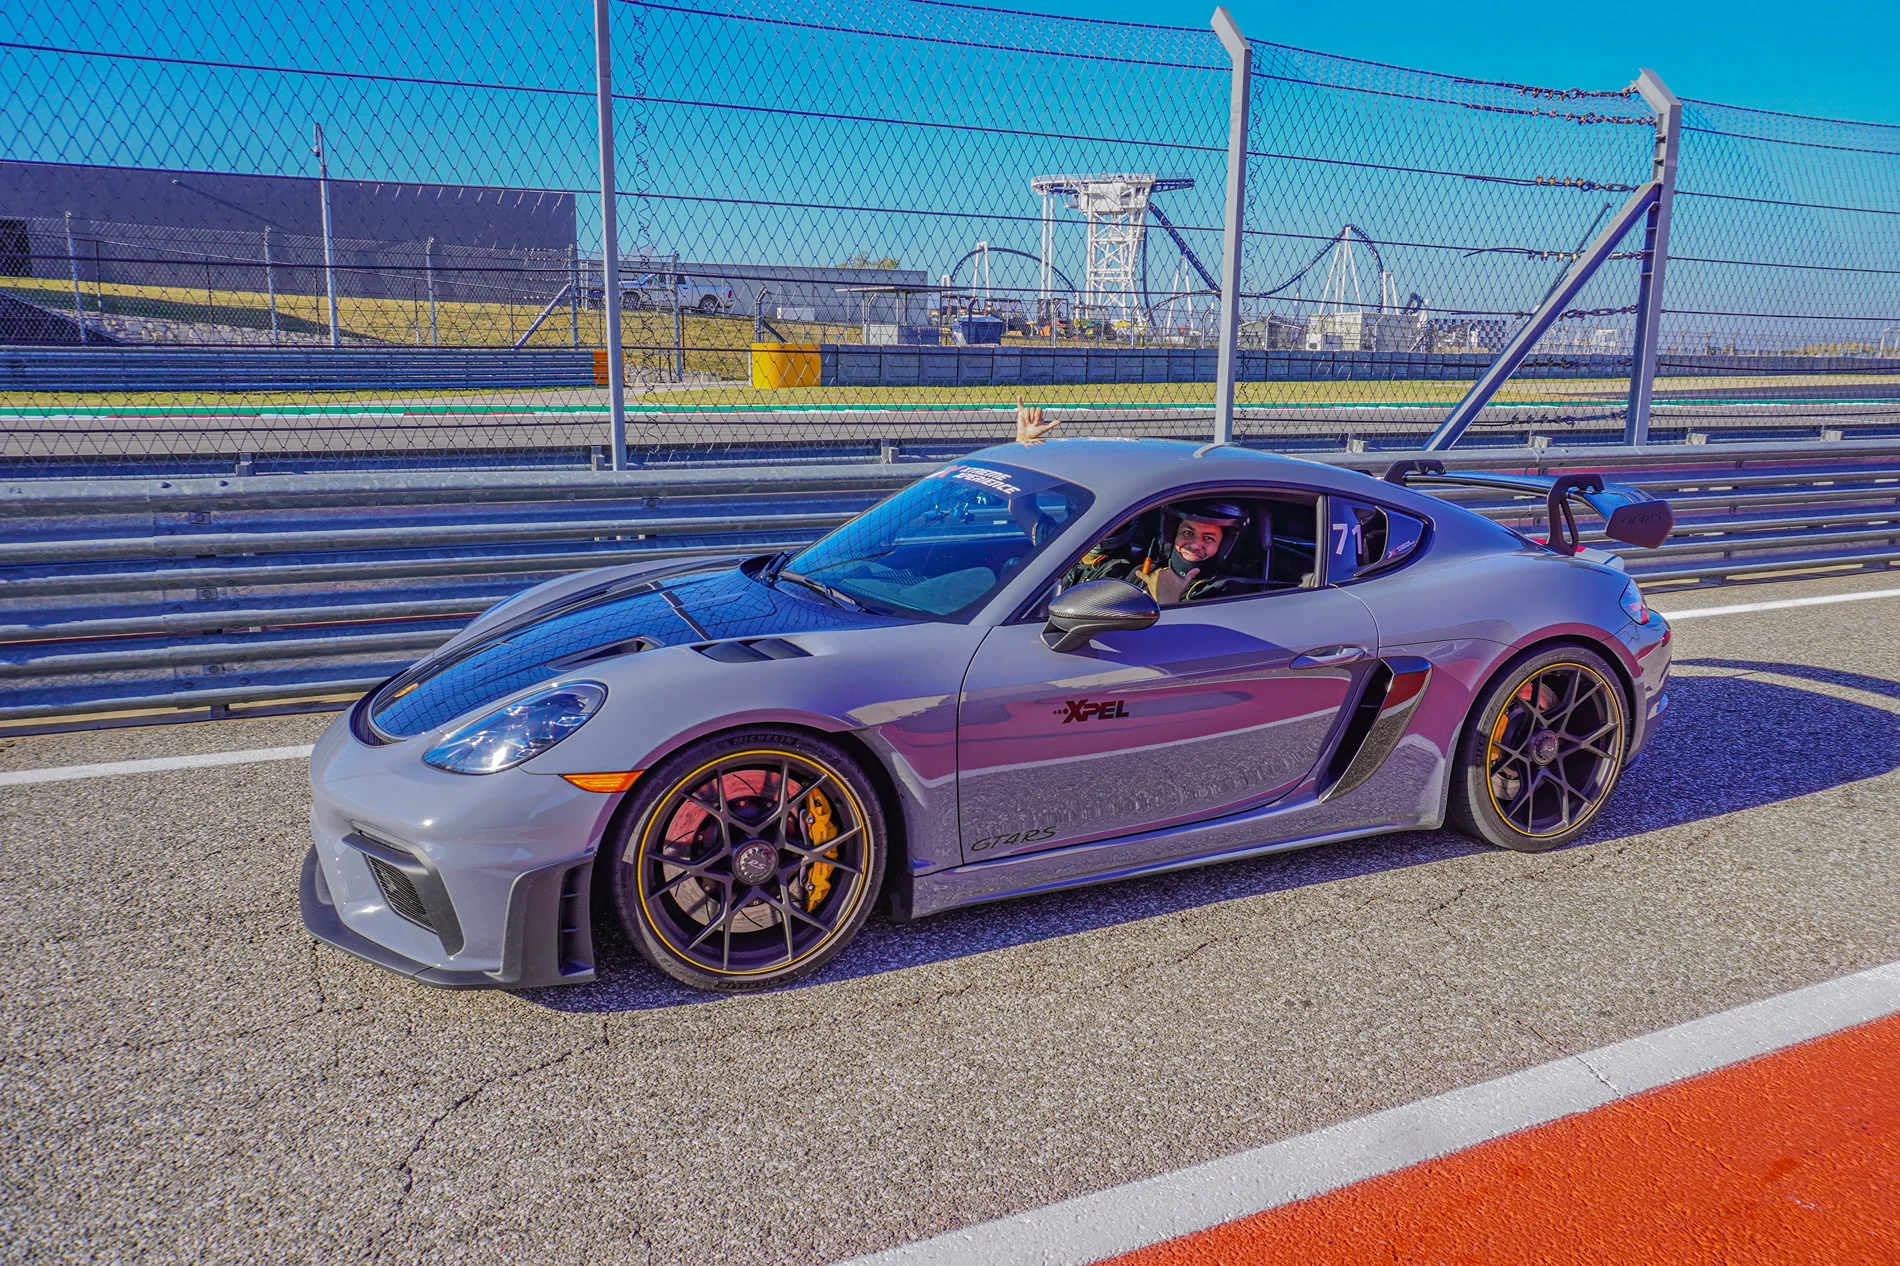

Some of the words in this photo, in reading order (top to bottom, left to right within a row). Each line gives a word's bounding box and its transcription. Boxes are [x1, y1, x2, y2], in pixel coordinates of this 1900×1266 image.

[952, 473, 1021, 495] XPERIENCE
[1332, 523, 1363, 555] 71
[1062, 699, 1130, 724] XPEL
[733, 735, 796, 746] MICHELIN
[971, 826, 1056, 851] GT4RS
[747, 860, 767, 870] RS
